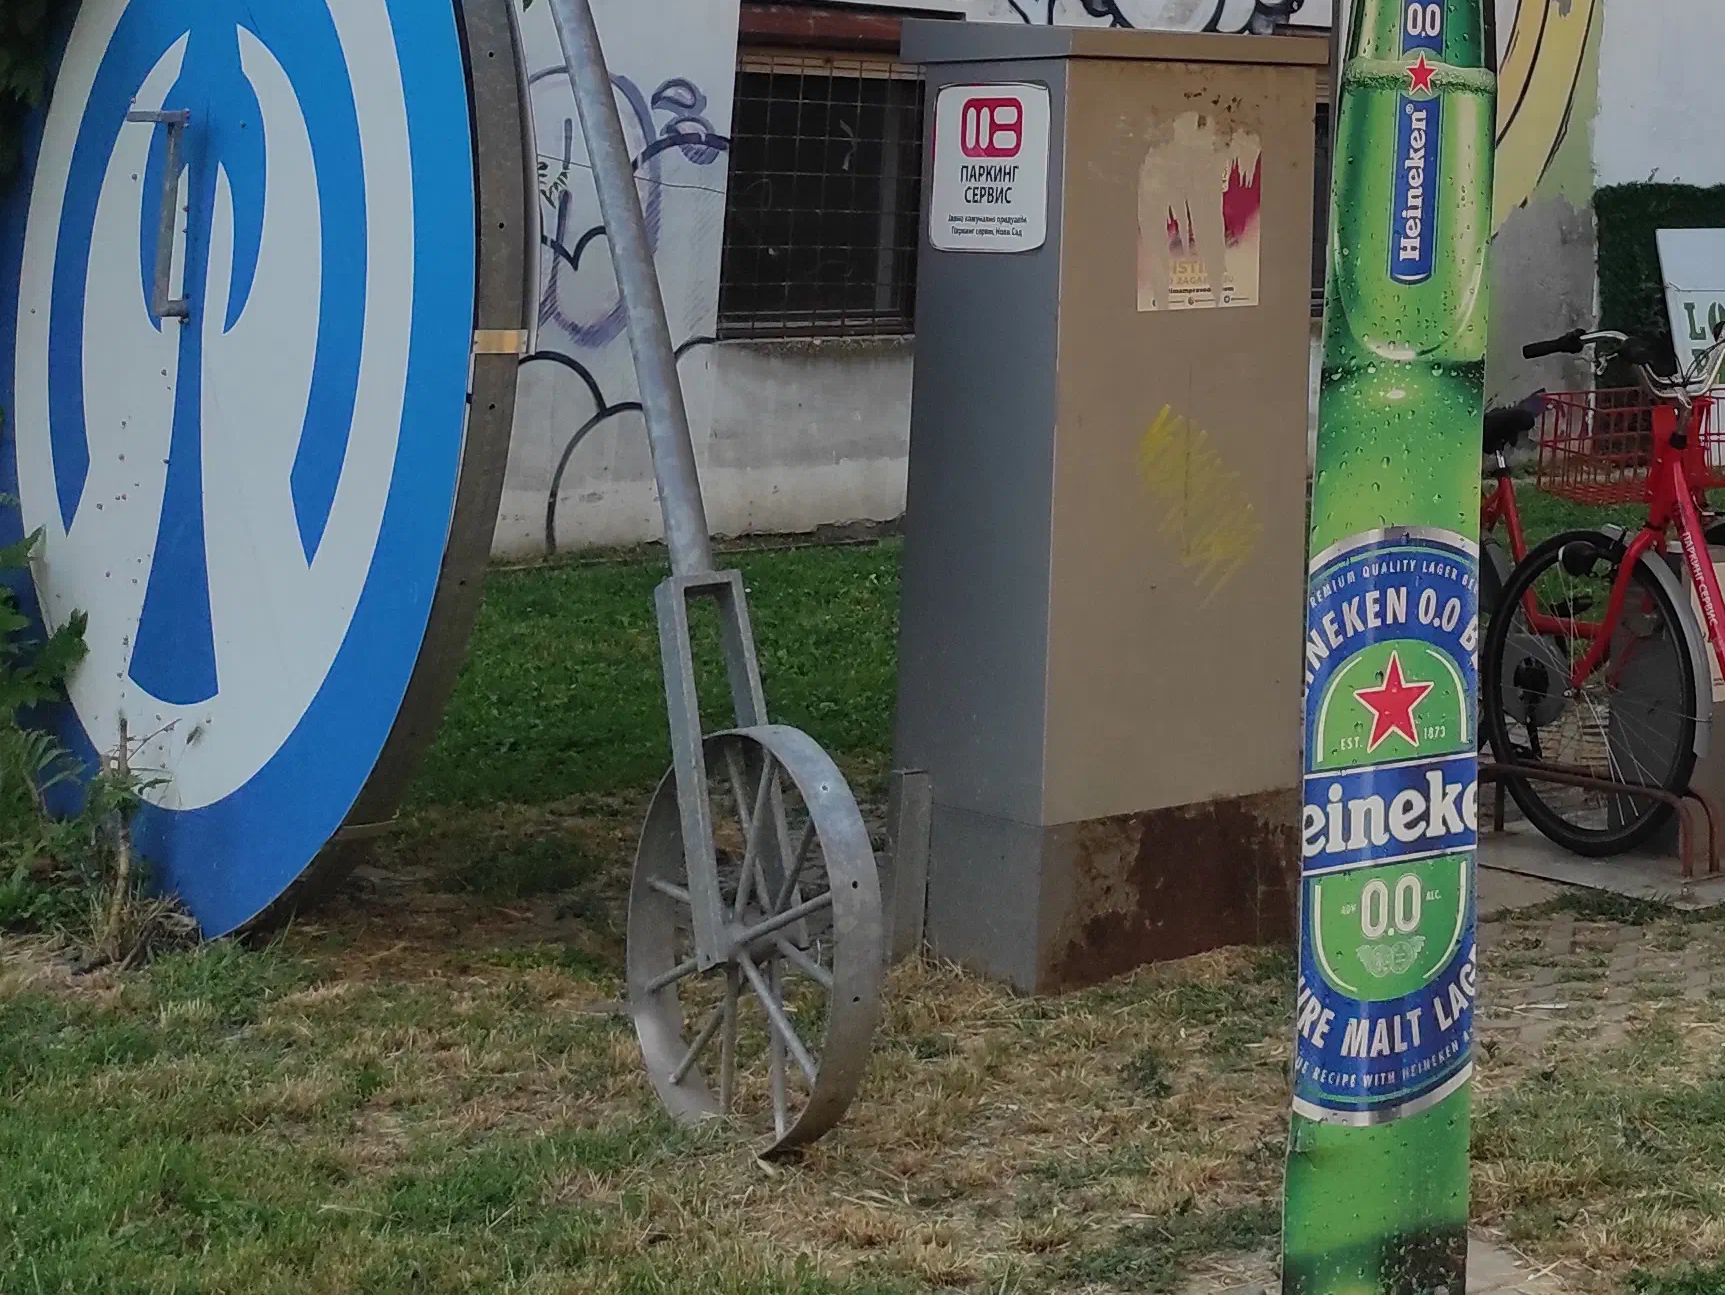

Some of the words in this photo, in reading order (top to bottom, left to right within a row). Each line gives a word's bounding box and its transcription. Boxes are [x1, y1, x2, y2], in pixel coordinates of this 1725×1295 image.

[1407, 3, 1440, 38] 0.0
[960, 165, 1019, 183] ПАРКИНГ
[964, 186, 1012, 204] СЕРВИС
[1399, 109, 1427, 261] Heineken
[1310, 571, 1355, 609] REMIUM
[1362, 560, 1416, 578] QUALITY
[1422, 560, 1461, 581] LAGER
[1682, 531, 1705, 583] ПАРКИНГ
[1698, 584, 1719, 626] СЕРВИС
[1418, 588, 1461, 632] 0.0
[1340, 736, 1363, 751] EST.
[1423, 726, 1446, 740] 1873
[1303, 769, 1478, 857] eineke
[1361, 873, 1421, 939] 0.0
[1340, 1008, 1422, 1058] MALT
[1312, 1067, 1357, 1090] RECIPE
[1363, 1071, 1395, 1089] WITH
[1402, 1039, 1459, 1081] HEINEKEN
